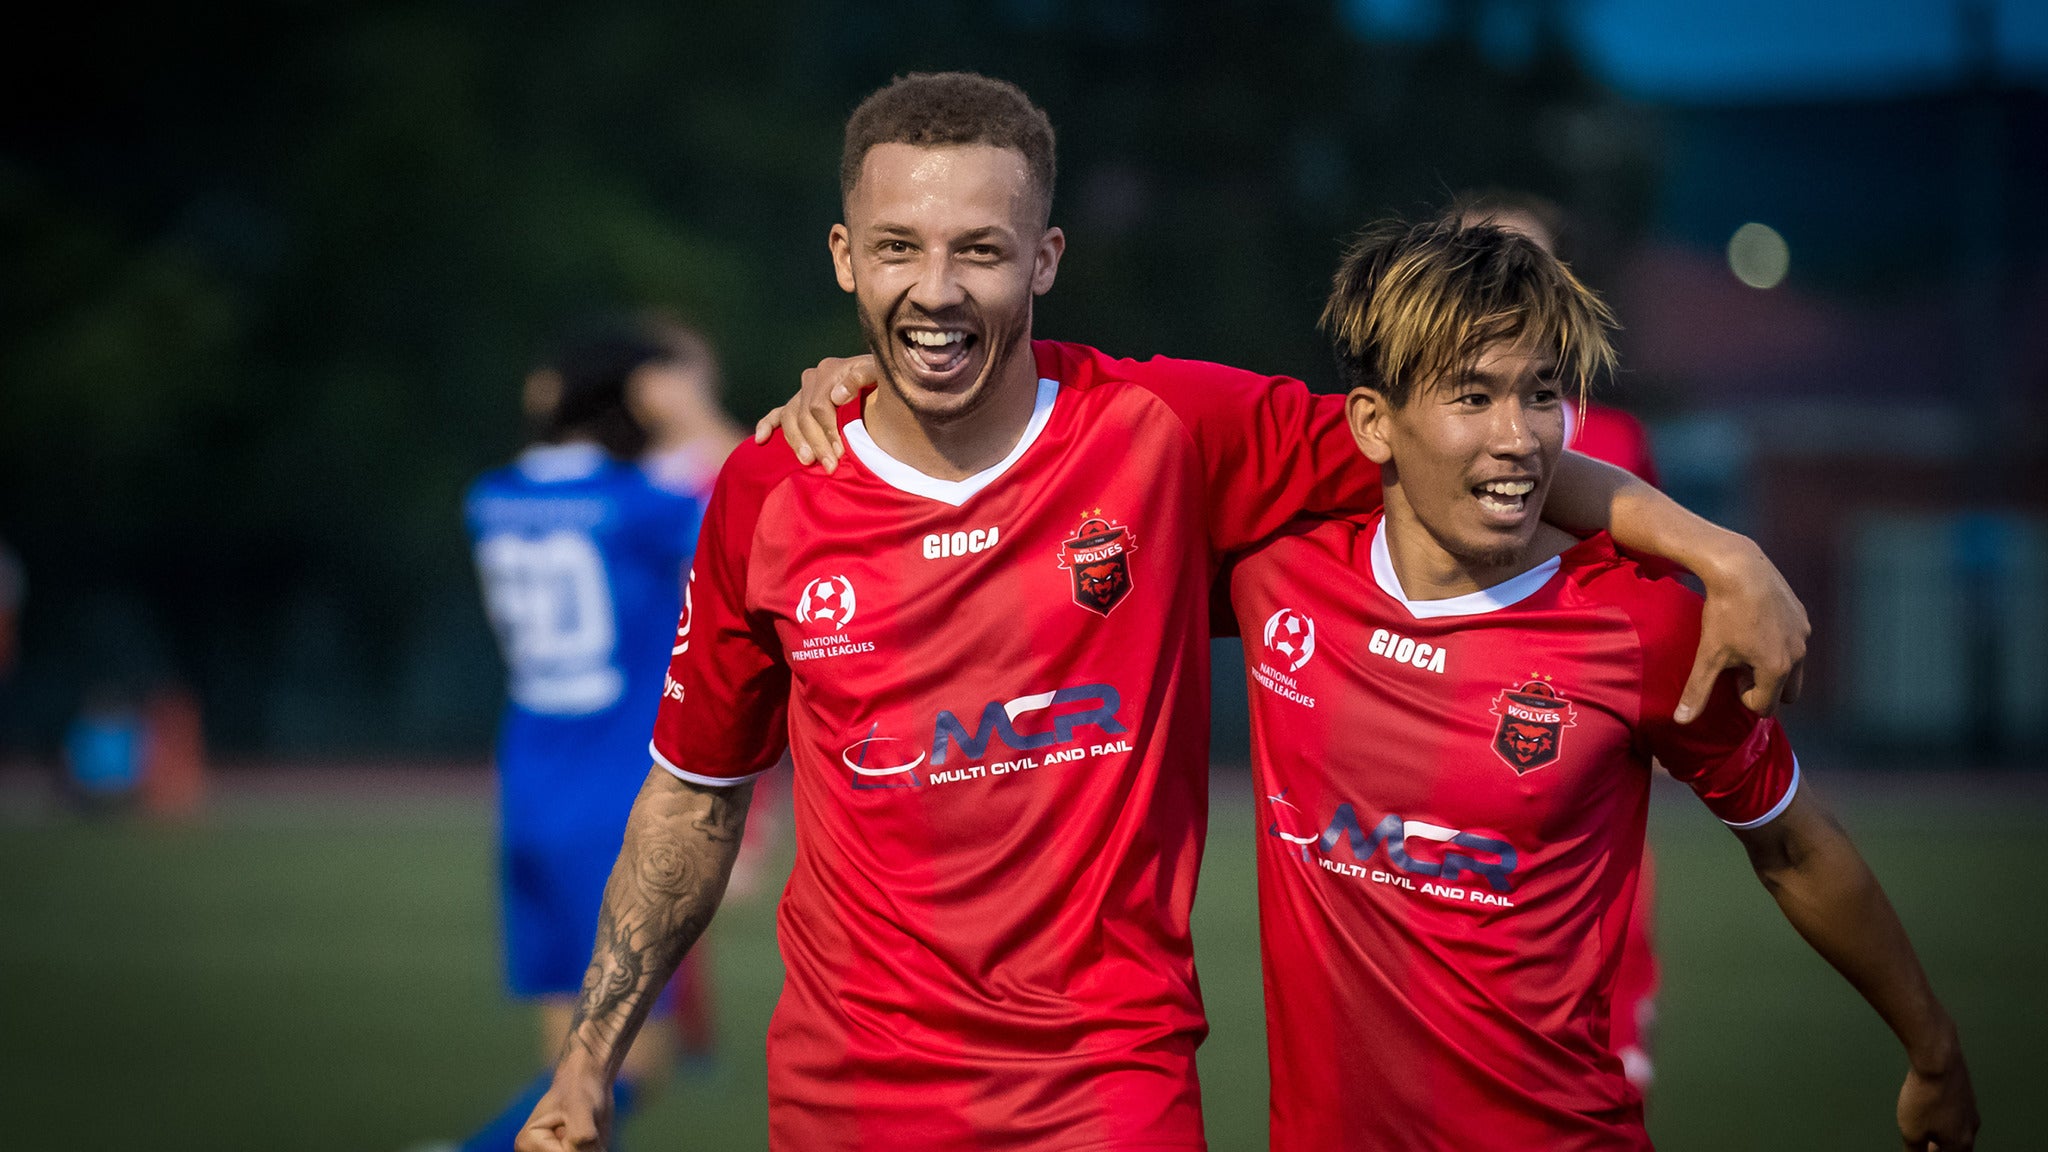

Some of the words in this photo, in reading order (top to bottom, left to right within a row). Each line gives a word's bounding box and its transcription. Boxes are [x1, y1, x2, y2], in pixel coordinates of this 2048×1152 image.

[923, 526, 999, 560] GIOCA
[1074, 543, 1123, 563] WOLVES
[792, 648, 826, 661] PREMIER
[827, 641, 875, 657] LEAGUES
[803, 633, 851, 648] NATIONAL
[1368, 628, 1447, 674] GIOCA
[1260, 662, 1298, 690] NATIONAL
[1274, 683, 1316, 709] LEAGUES
[930, 682, 1129, 766] MCR
[1507, 704, 1561, 723] WOLVES
[929, 765, 987, 785] MULTI
[991, 757, 1039, 776] CIVIL
[1043, 747, 1086, 767] AND
[1090, 740, 1133, 757] RAIL
[1319, 802, 1519, 893] MCR
[1318, 857, 1366, 879] MULTI
[1371, 869, 1417, 891] CIVIL
[1420, 882, 1465, 900] AND
[1469, 891, 1515, 908] RAIL
